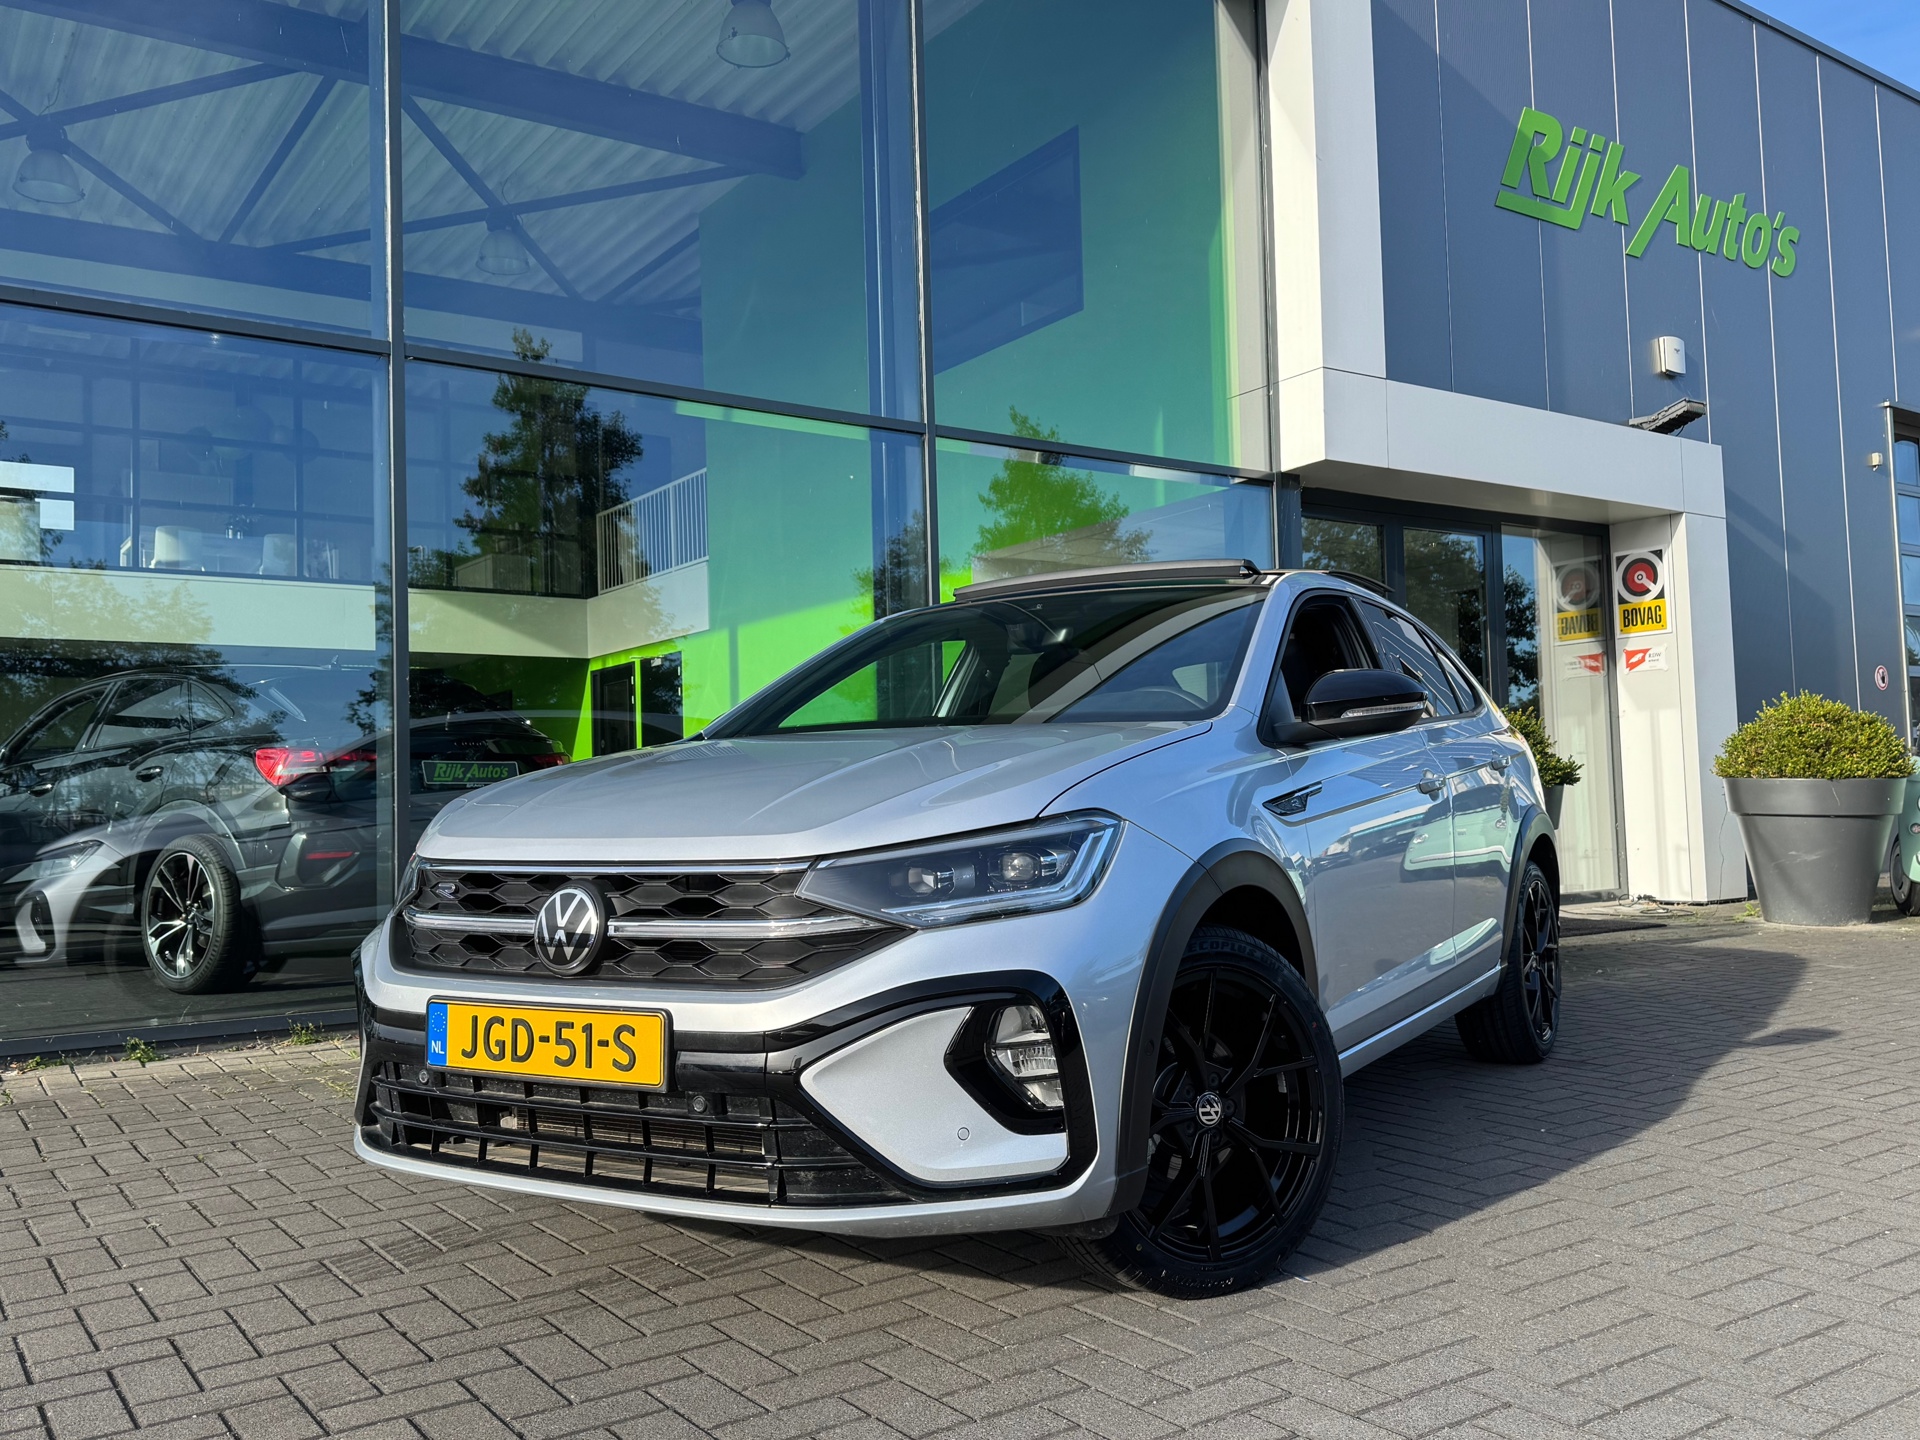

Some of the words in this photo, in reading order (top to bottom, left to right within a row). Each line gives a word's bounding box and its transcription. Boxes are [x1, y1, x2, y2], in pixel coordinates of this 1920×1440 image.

[1495, 106, 1642, 231] Rijk
[1625, 164, 1800, 278] Auto's
[1622, 604, 1663, 629] BOVAG
[433, 763, 466, 781] Rijk
[463, 763, 509, 782] Auto's
[431, 1040, 445, 1055] NL
[461, 1014, 637, 1073] JGD-51-S
